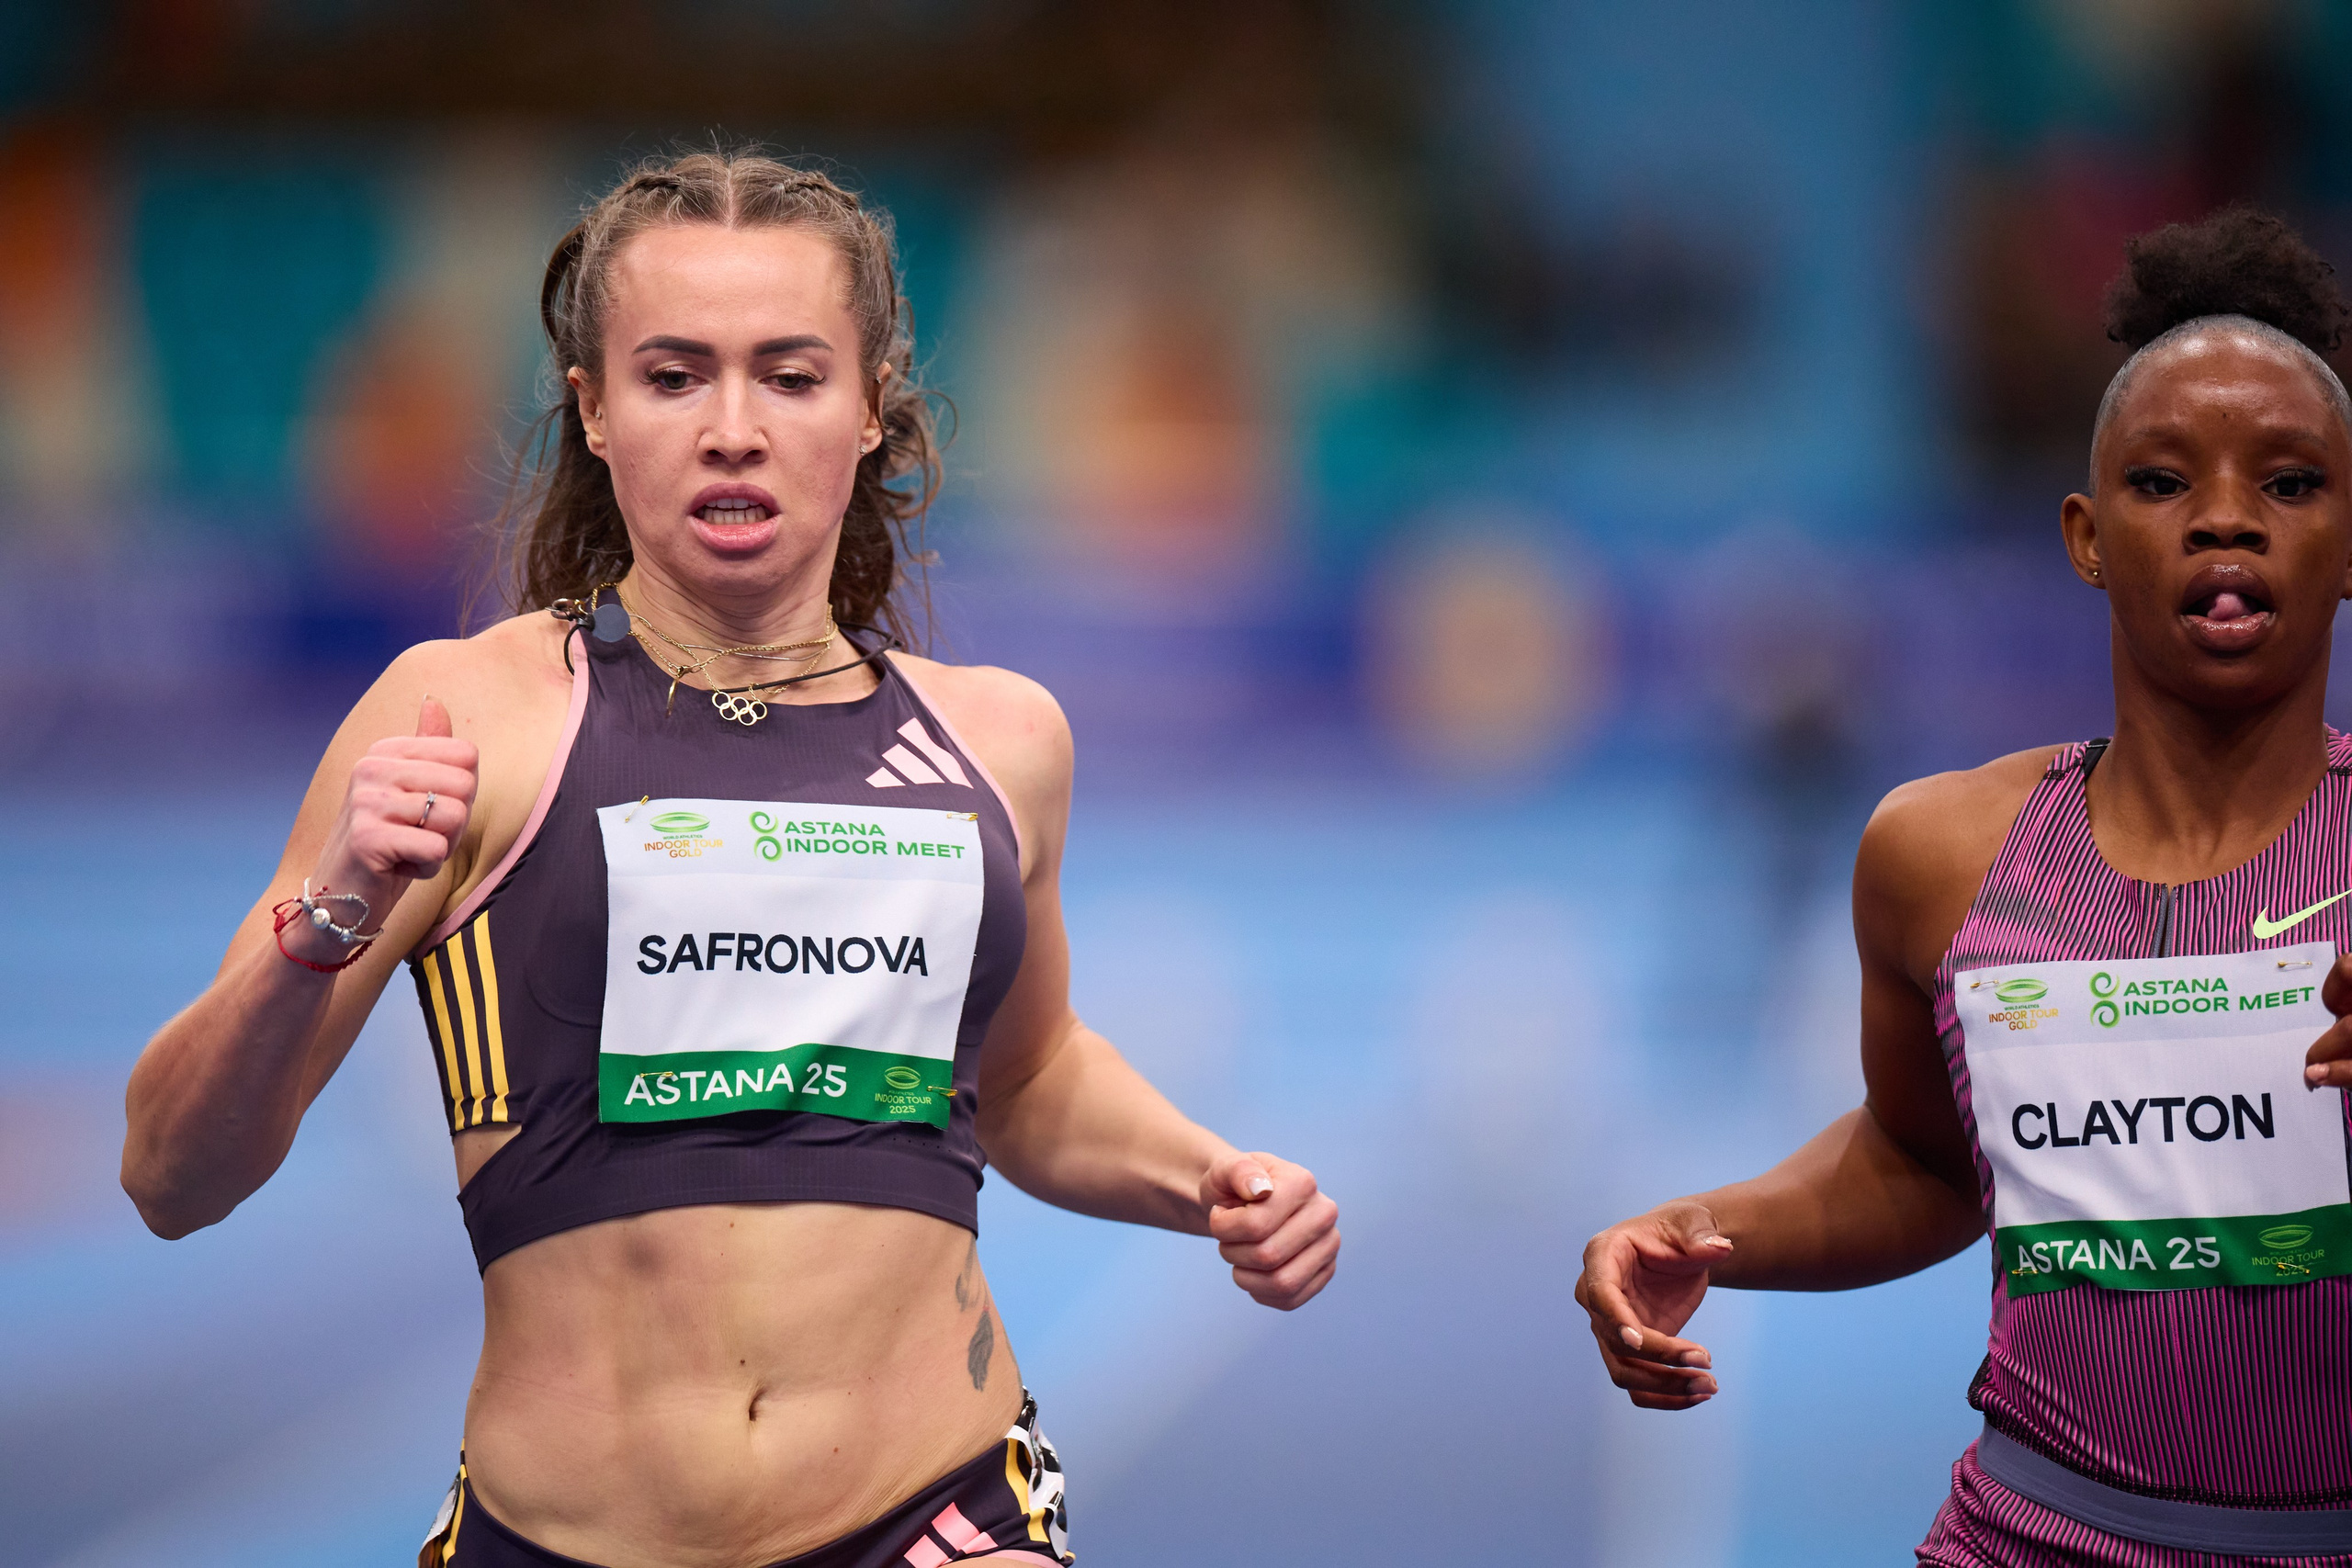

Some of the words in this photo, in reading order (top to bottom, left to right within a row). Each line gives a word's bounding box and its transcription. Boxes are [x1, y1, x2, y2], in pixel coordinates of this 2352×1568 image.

[785, 820, 886, 837] ASTANA
[644, 840, 690, 852] INDOOR
[693, 839, 723, 849] TOUR
[669, 848, 702, 858] GOLD
[786, 838, 888, 855] INDOOR
[897, 841, 965, 859] MEET
[637, 932, 928, 976] SAFRONOVA
[2123, 977, 2229, 997] ASTANA
[2125, 997, 2230, 1016] INDOOR
[2239, 987, 2315, 1010] MEET
[1989, 1010, 2027, 1022] INDOOR
[2030, 1009, 2058, 1019] TOUR
[2008, 1020, 2037, 1031] GOLD
[624, 1063, 795, 1106] ASTANA
[801, 1062, 847, 1097] 25
[875, 1093, 905, 1104] INDOOR
[905, 1096, 932, 1104] TOUR
[889, 1105, 916, 1114] 2025
[2012, 1092, 2275, 1150] CLAYTON
[2018, 1239, 2156, 1276] ASTANA
[2165, 1236, 2221, 1270] 25
[2252, 1255, 2294, 1266] INDOOR
[2297, 1249, 2324, 1262] TOUR
